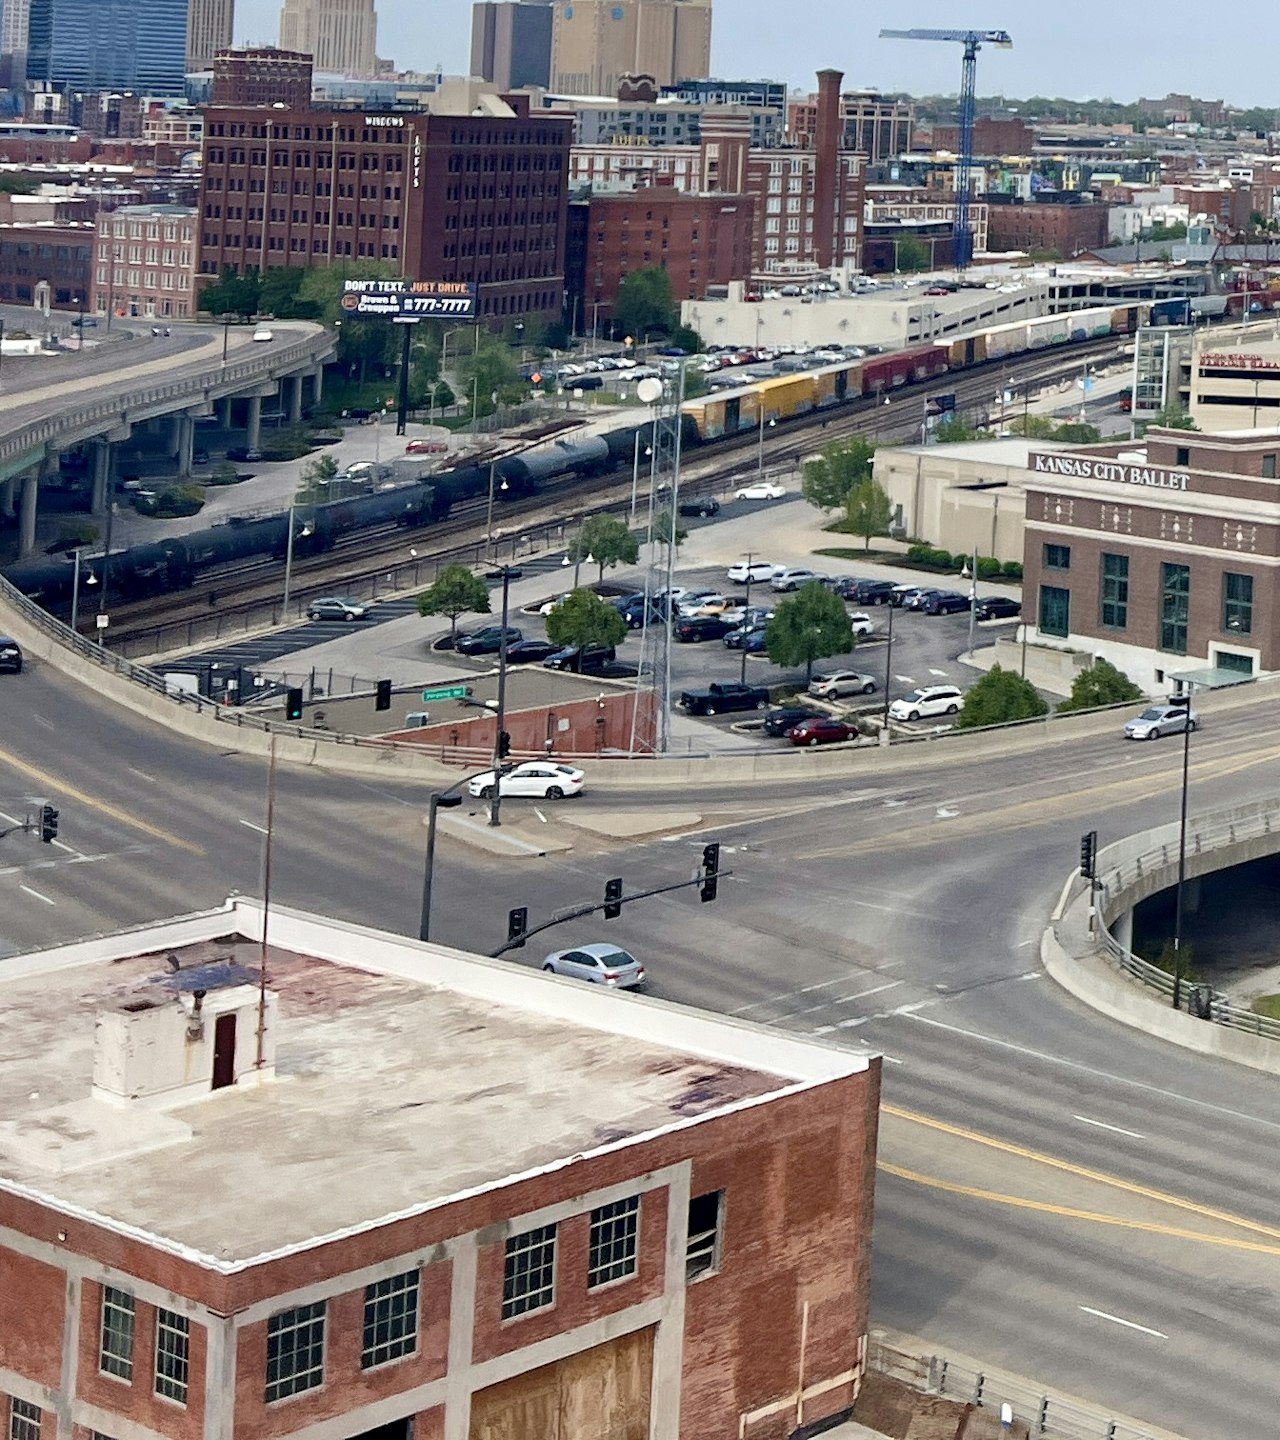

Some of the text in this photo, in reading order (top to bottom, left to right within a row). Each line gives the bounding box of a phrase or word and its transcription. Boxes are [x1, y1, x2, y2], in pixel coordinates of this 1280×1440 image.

[344, 280, 470, 294] DON'T TEXT. JUST DRIVE.
[414, 298, 471, 312] 777-7777
[1035, 455, 1190, 490] KANSAS CITY BALLET
